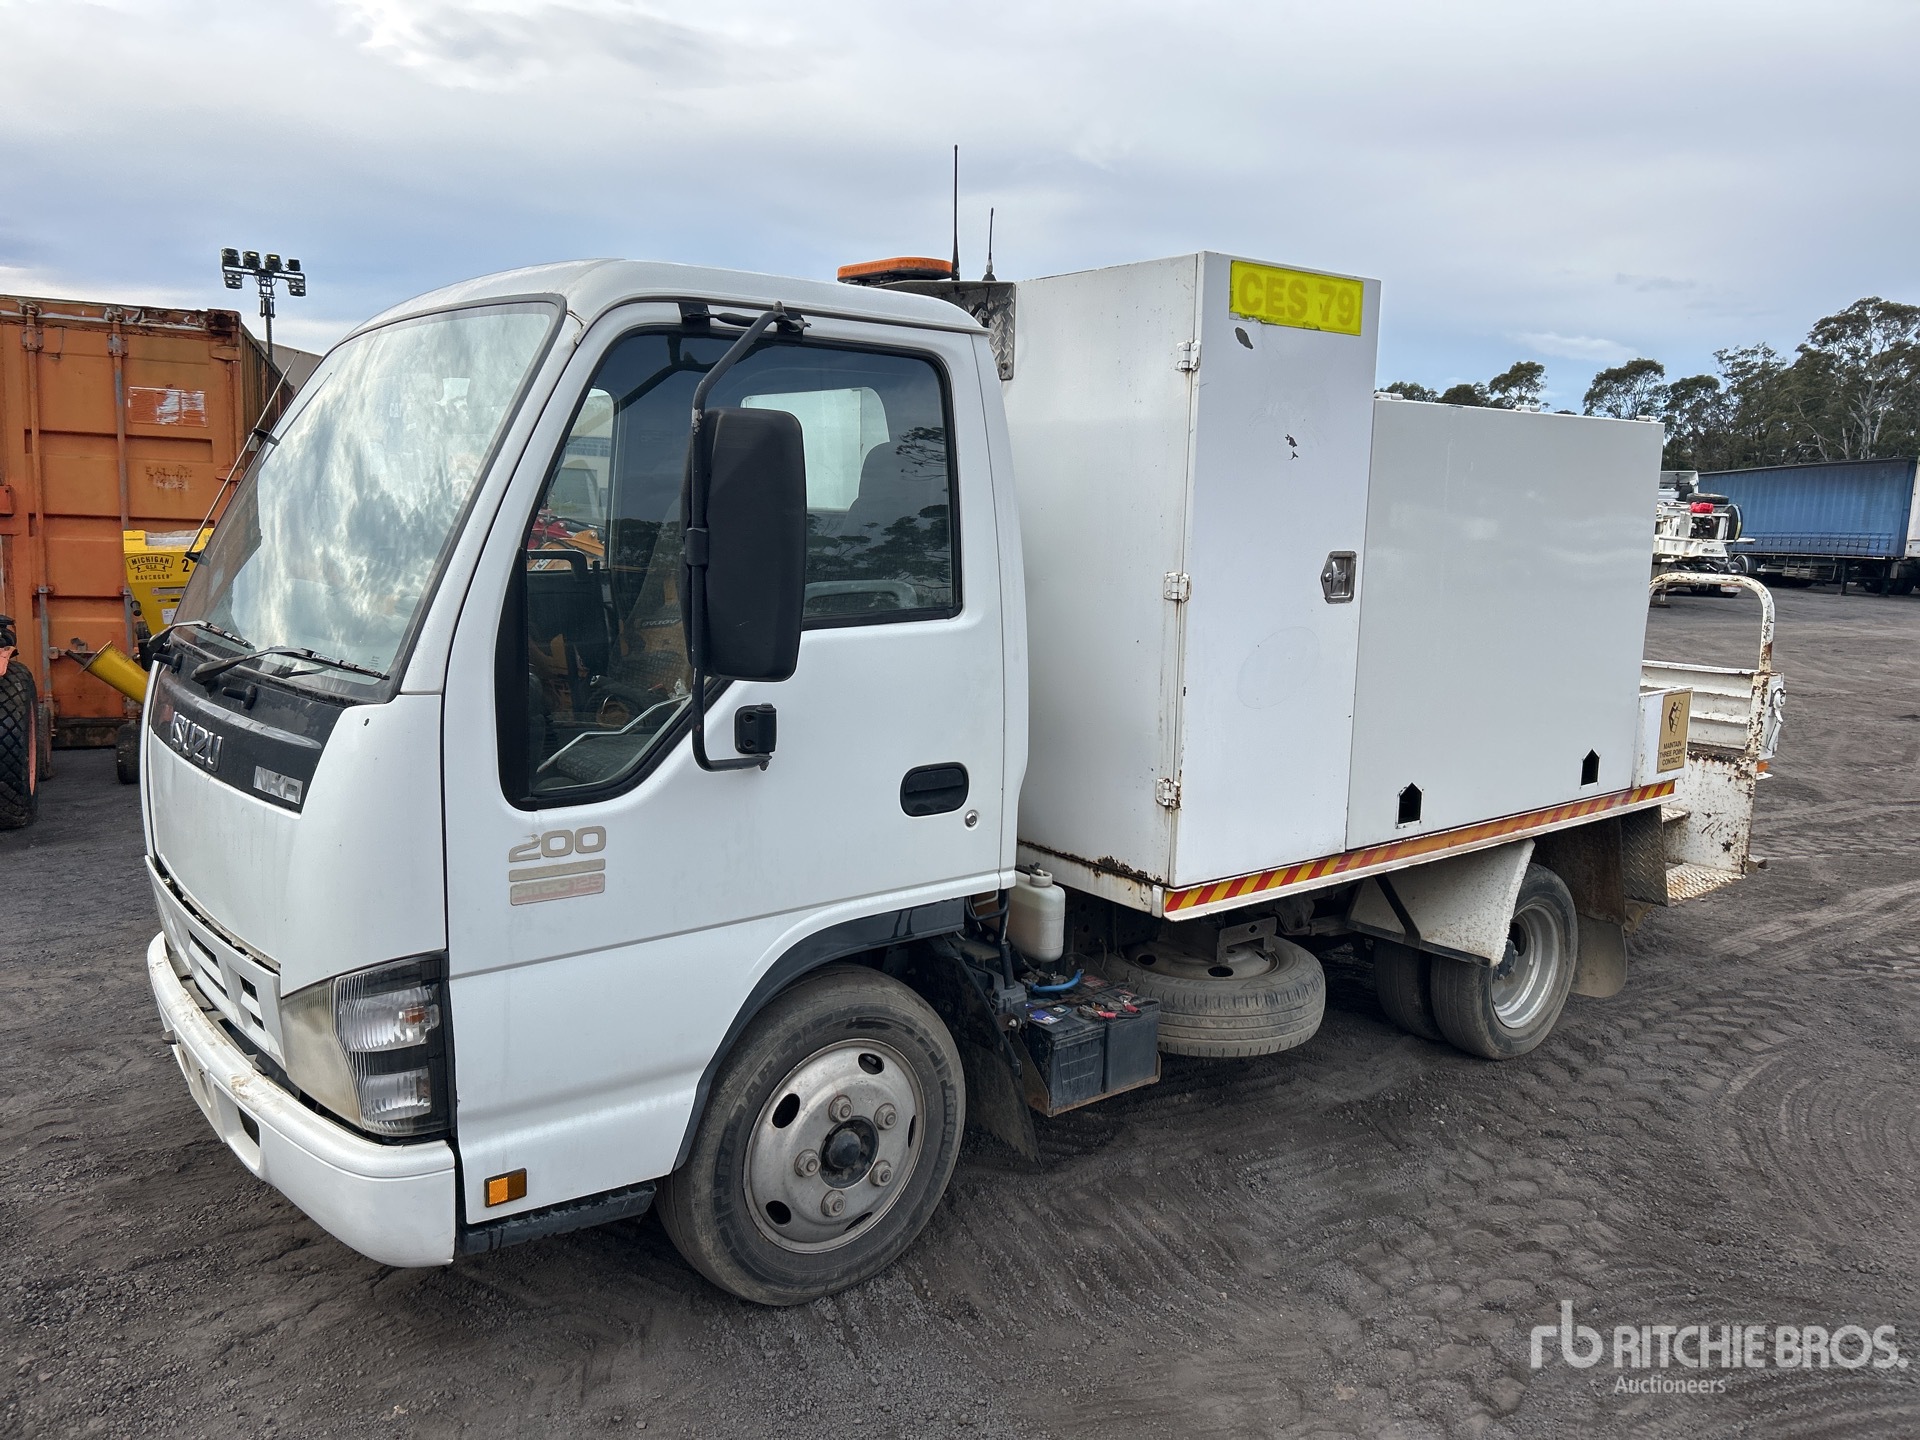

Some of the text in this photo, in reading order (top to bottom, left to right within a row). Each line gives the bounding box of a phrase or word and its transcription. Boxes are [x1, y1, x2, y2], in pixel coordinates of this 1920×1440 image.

[1239, 272, 1355, 325] CES 79
[131, 555, 170, 565] MICHIGAN
[170, 711, 223, 772] ISUZU
[1660, 747, 1685, 758] THREE POINT
[1663, 740, 1682, 749] MAINTAIN
[1662, 755, 1681, 766] CONTACT
[253, 765, 303, 804] NKR
[509, 825, 607, 863] 200
